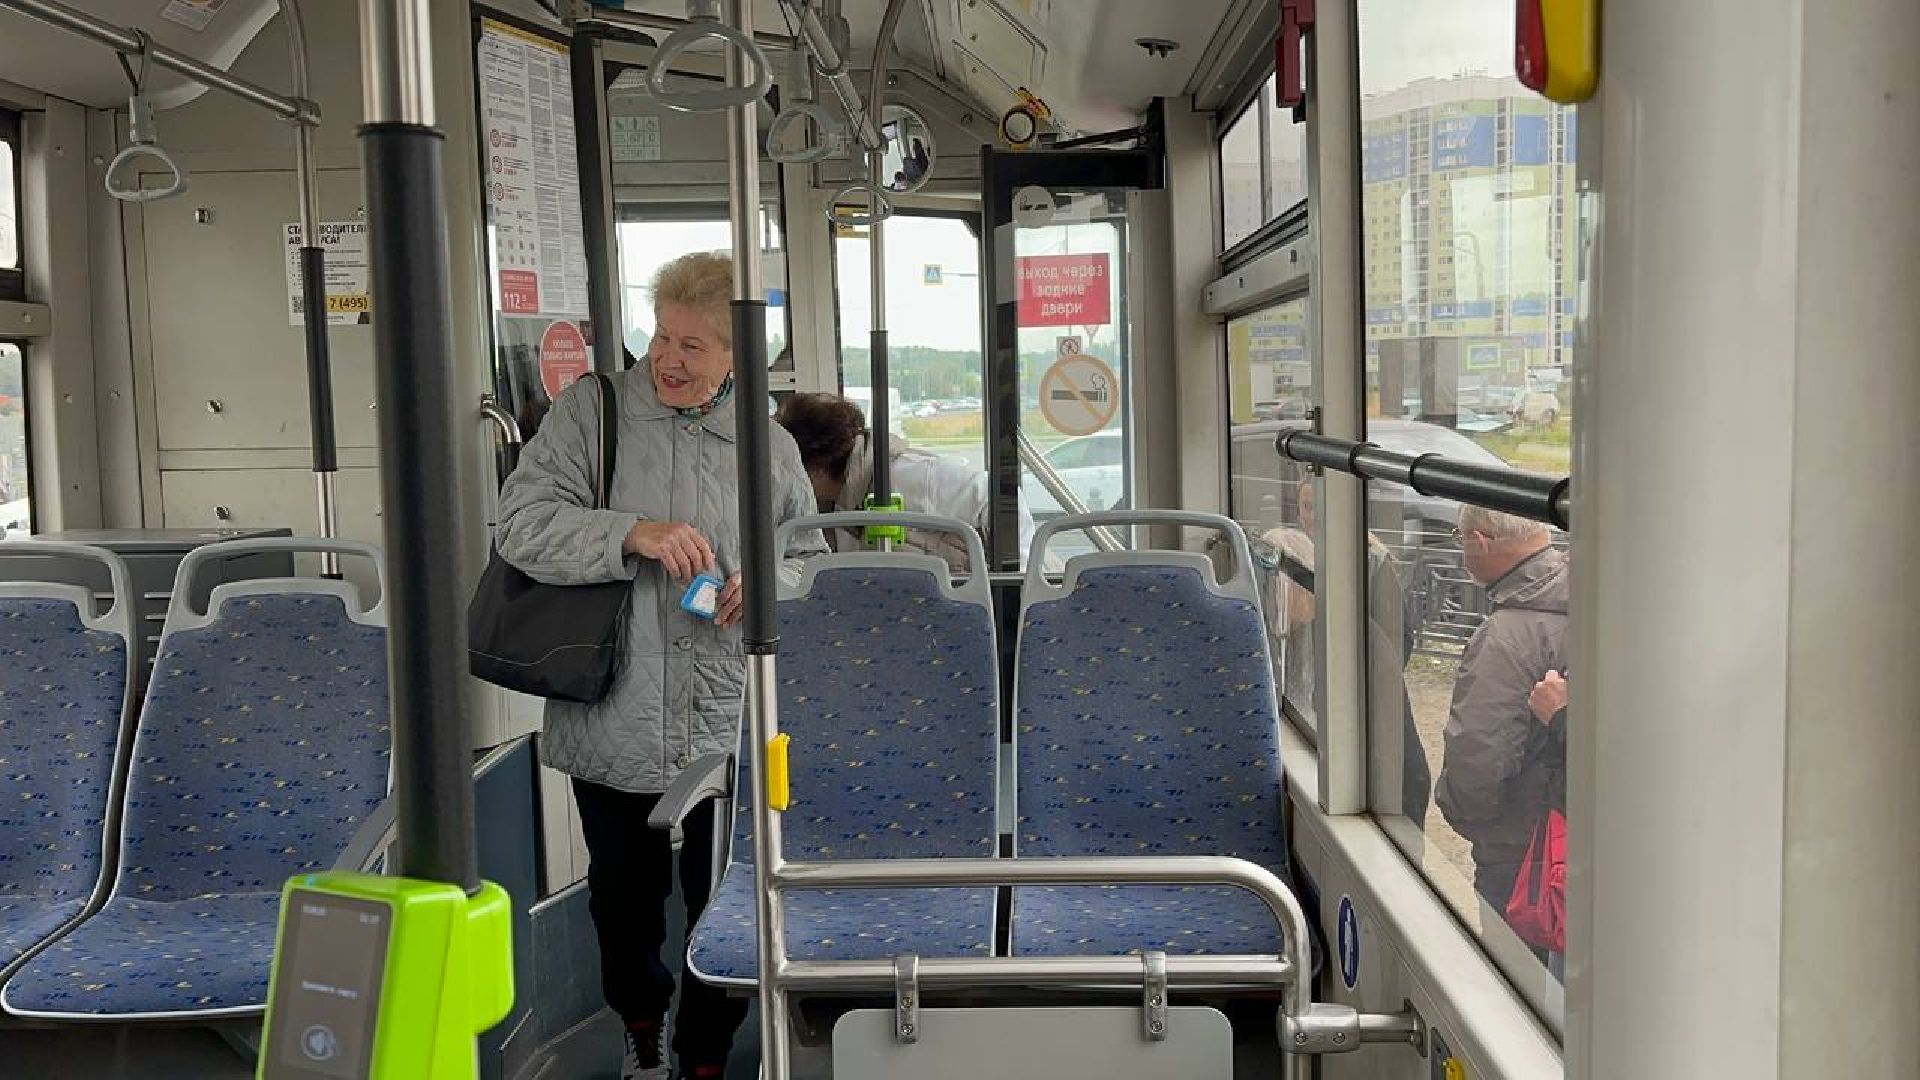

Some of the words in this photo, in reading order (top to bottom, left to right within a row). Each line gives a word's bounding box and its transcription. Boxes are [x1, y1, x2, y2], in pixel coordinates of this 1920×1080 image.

[319, 224, 368, 234] ВОДИТЕЛ
[339, 297, 368, 311] (495)
[504, 292, 521, 310] 112
[1041, 302, 1083, 318] двери
